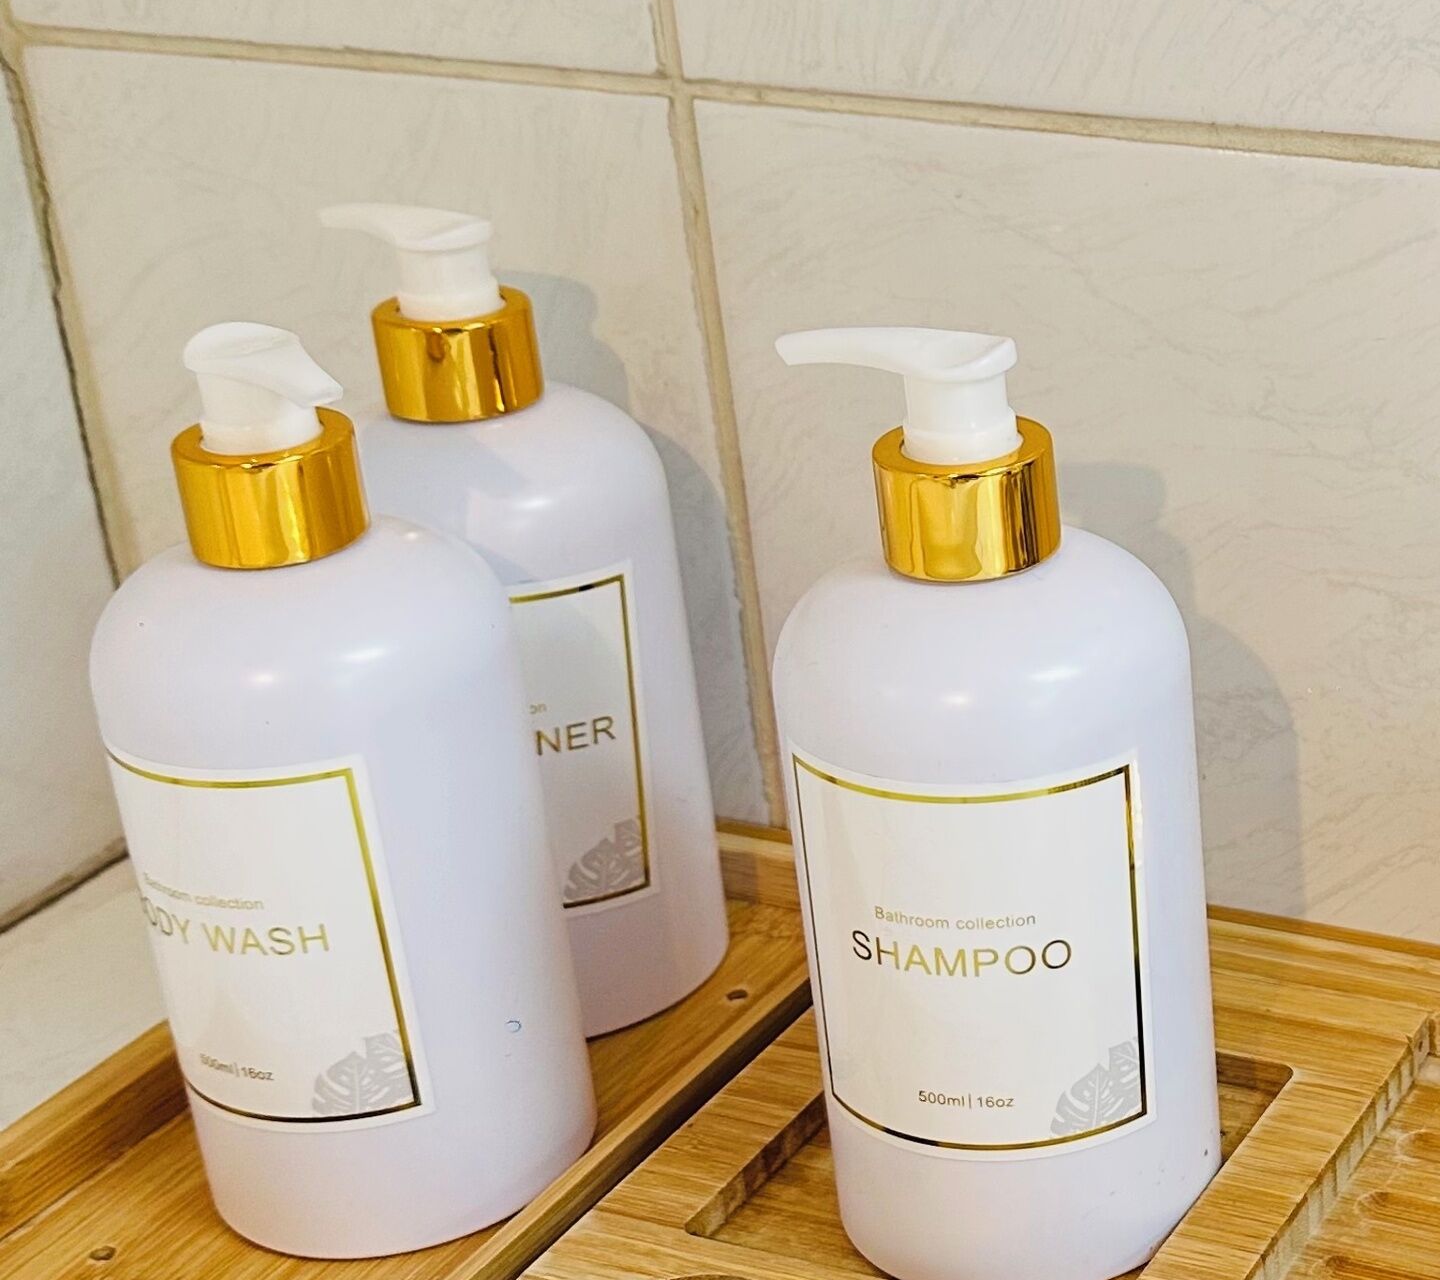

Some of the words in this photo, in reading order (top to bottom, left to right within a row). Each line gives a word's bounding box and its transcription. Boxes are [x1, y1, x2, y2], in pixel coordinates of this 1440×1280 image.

[874, 905, 950, 929] Bathroom
[956, 914, 1037, 931] collection
[201, 923, 330, 955] WASH
[852, 929, 1072, 978] SHAMPOO
[977, 1096, 1015, 1108] 16oz
